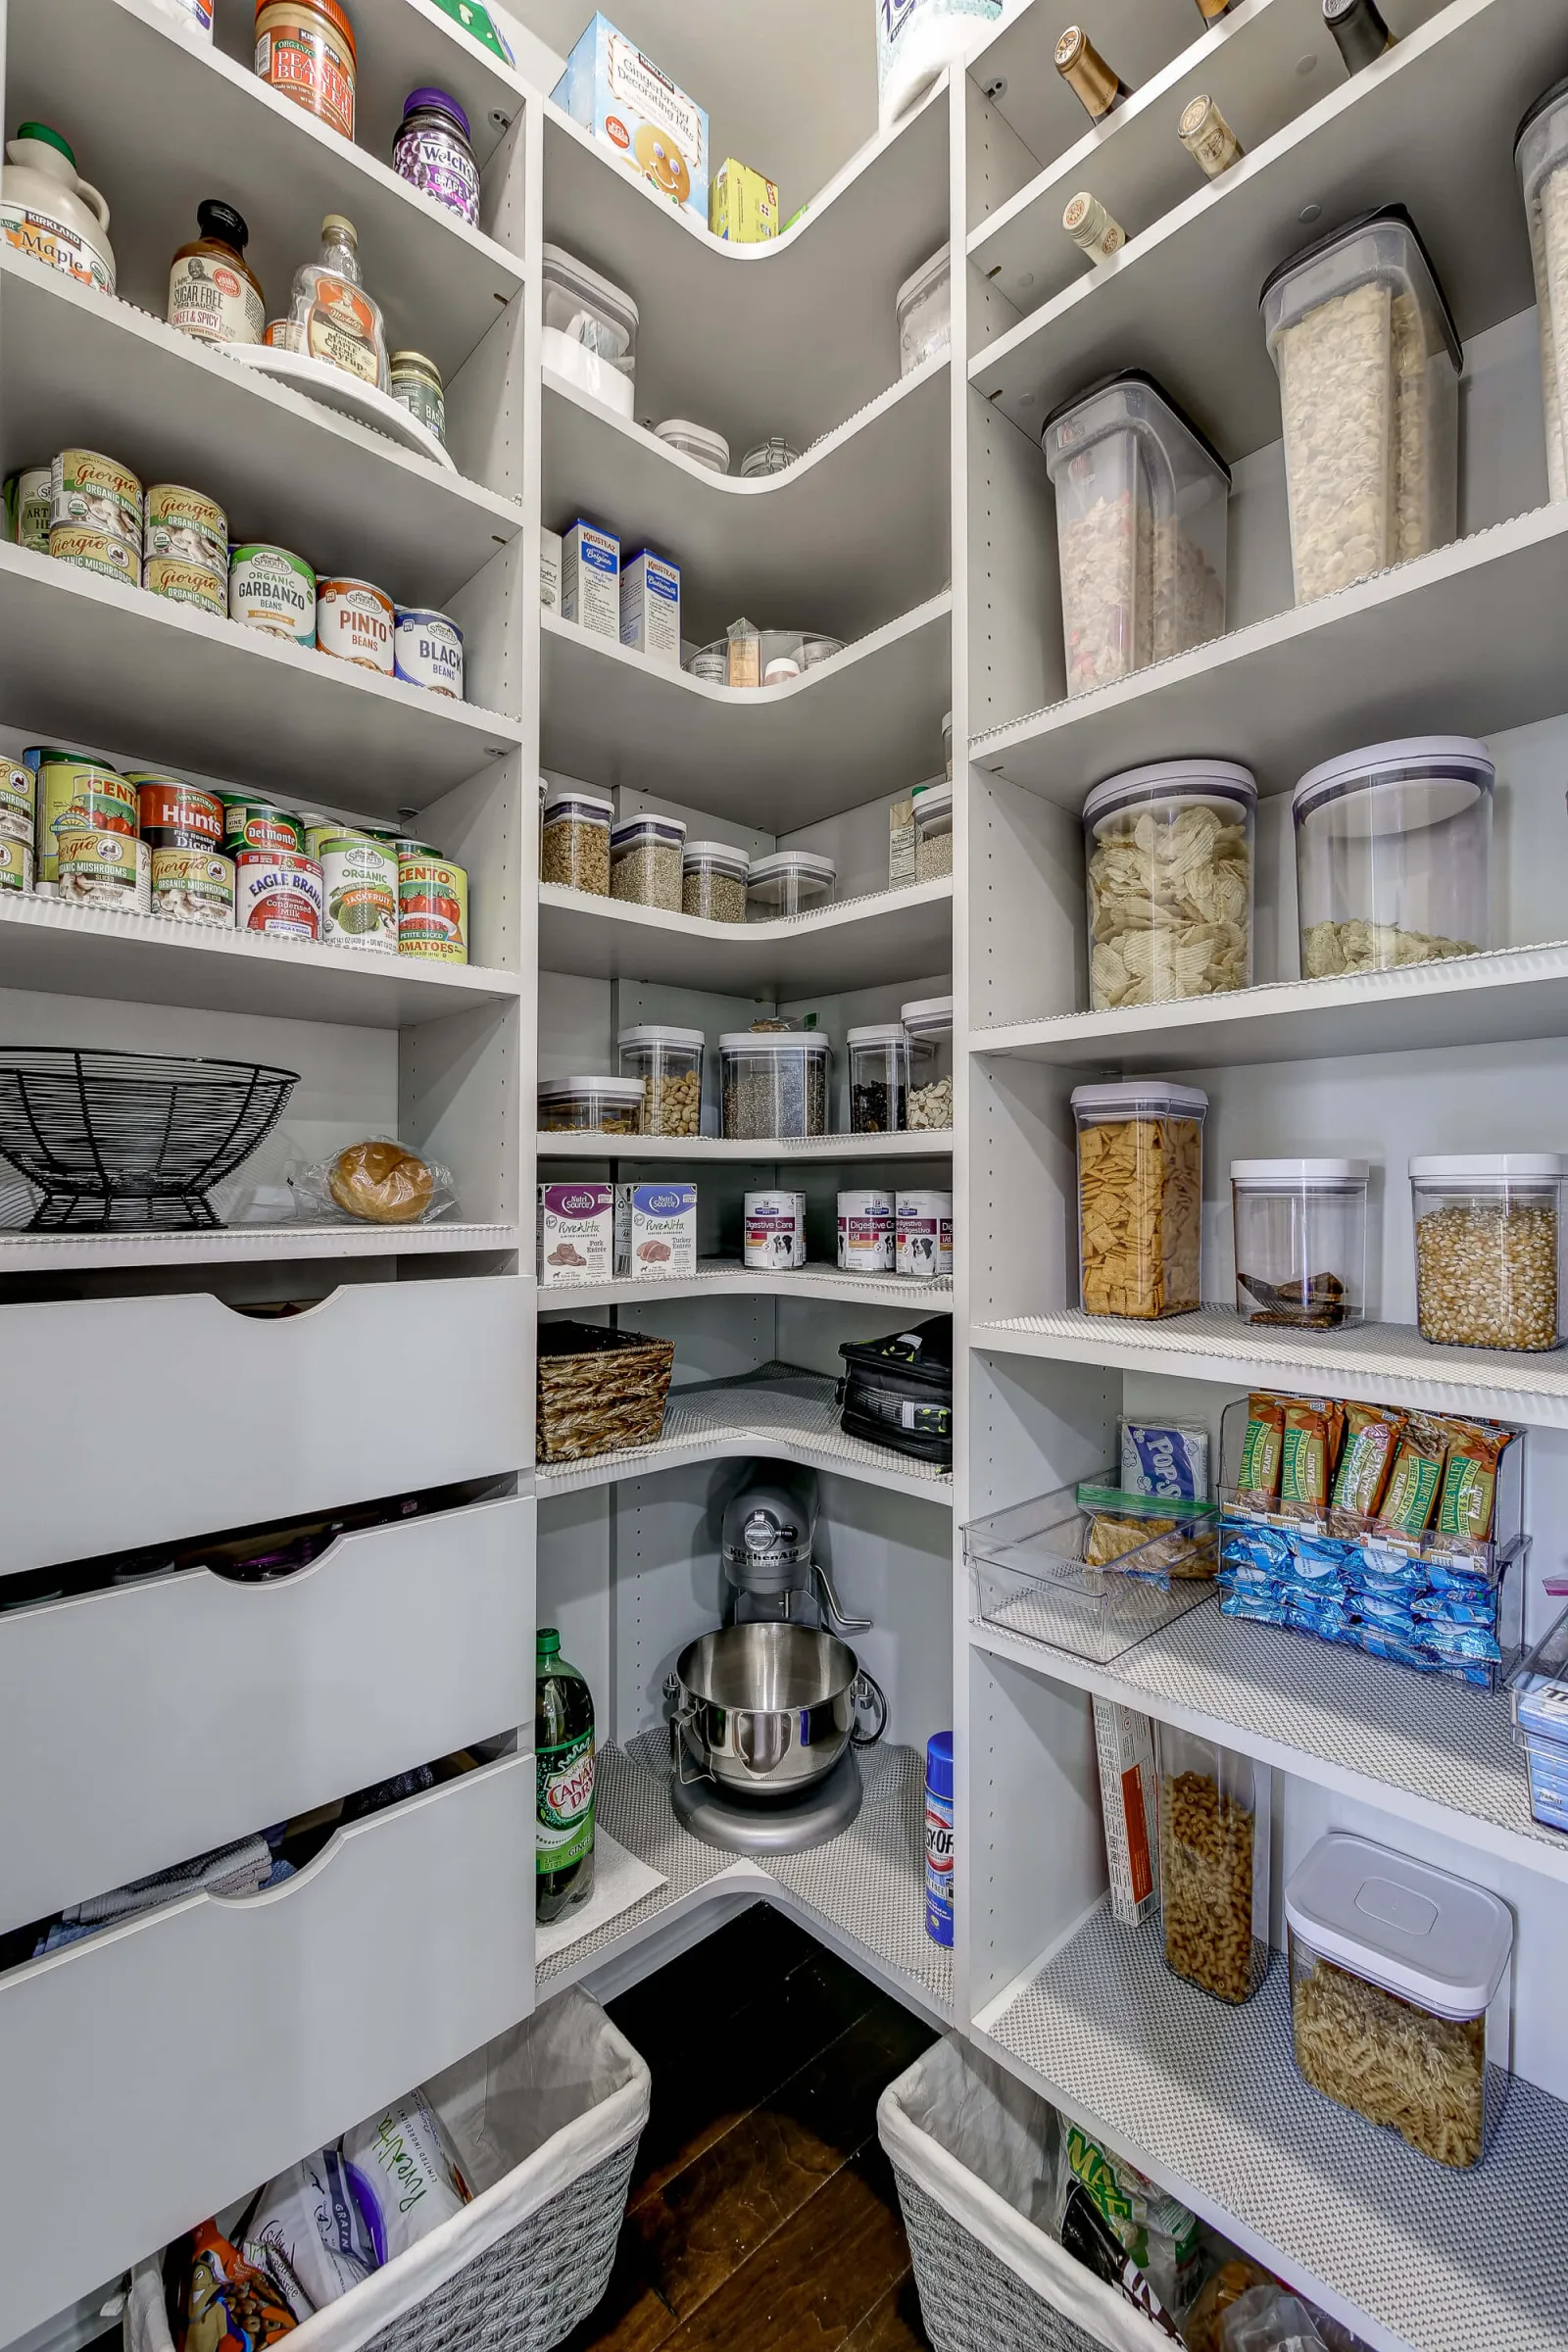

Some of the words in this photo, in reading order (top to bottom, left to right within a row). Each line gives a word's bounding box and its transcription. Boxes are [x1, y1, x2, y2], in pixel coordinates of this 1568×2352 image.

[278, 40, 317, 58] ORGANIC
[301, 29, 340, 65] KIRAND
[277, 51, 351, 106] PEANUT
[277, 65, 349, 121] BUTTER
[623, 59, 690, 124] Gingerbread
[616, 66, 674, 121] Decorating
[676, 112, 695, 143] Kits
[422, 145, 474, 178] Welch's
[434, 172, 465, 200] GRAPE
[28, 213, 80, 246] KIRKLAND
[22, 230, 83, 273] Maple
[173, 286, 198, 307] SUGAR
[200, 286, 224, 310] FREE
[191, 302, 216, 312] SAUCE
[173, 311, 190, 324] SWEET
[197, 311, 220, 328] SPICY
[330, 310, 362, 330] Michele's
[327, 332, 359, 354] MAPLE
[330, 348, 365, 372] Syrup
[76, 464, 138, 494] Giorgio
[85, 483, 121, 505] ORGANIC
[159, 496, 219, 520] Giorgio
[168, 515, 200, 532] ORGANIC
[52, 533, 109, 558] Giorgio
[583, 531, 615, 553] KRUSTEAZ
[254, 557, 290, 571] SPROUTS
[586, 548, 612, 565] Belgian
[85, 560, 133, 584] MUSHROOMS
[159, 568, 219, 594] Giorgio
[248, 571, 295, 589] ORGANIC
[648, 561, 677, 582] KRUSTEAZ
[168, 587, 200, 604] ORGANIC
[238, 581, 305, 611] GARBANZO
[647, 574, 677, 596] Buttermilk
[260, 599, 282, 612] BEANS
[349, 594, 381, 612] SPROUTS
[340, 610, 387, 643] PINTO
[352, 634, 378, 652] BEANS
[419, 639, 462, 674] BLACK
[432, 663, 456, 681] BEANS
[0, 790, 31, 811] SHROOMS
[87, 778, 135, 808] CENT
[192, 795, 215, 809] NATURAL
[163, 805, 221, 836] Hunt's
[176, 836, 215, 853] Diced
[190, 832, 217, 846] Roasted
[249, 827, 266, 839] Del
[266, 829, 296, 846] Monte
[76, 862, 127, 877] MUSHROOMS
[154, 857, 209, 879] Giorgio
[348, 852, 383, 865] SPROUTS
[341, 869, 388, 883] ORGANIC
[398, 867, 450, 883] CENTO
[158, 879, 186, 889] ORGANIC
[187, 880, 229, 898] MUSHROOMS
[249, 873, 289, 897] EAGLE
[292, 874, 321, 909] BRAND
[345, 893, 391, 906] JACKFRUIT
[266, 900, 312, 913] Condensed
[280, 907, 301, 918] Milk
[398, 941, 454, 954] OMATOES
[850, 1220, 886, 1231] Digestive
[1244, 1423, 1262, 1451] VALLEY
[1260, 1424, 1272, 1438] NUT
[1300, 1431, 1311, 1447] NUT
[1254, 1439, 1265, 1458] SALTY
[1285, 1431, 1300, 1460] VALLEY
[1239, 1451, 1255, 1488] NATURE
[1262, 1445, 1273, 1474] PEANUT
[1296, 1448, 1304, 1469] SALTY
[1306, 1451, 1316, 1484] PEANUT
[1408, 1456, 1418, 1479] SWEET
[1466, 1460, 1480, 1478] NUT
[1252, 1466, 1261, 1490] SWEET
[1283, 1460, 1298, 1499] NATURE
[1419, 1458, 1436, 1499] NATURE
[1450, 1458, 1466, 1493] VALLEY
[1297, 1476, 1309, 1500] SWEET
[1391, 1472, 1407, 1504] PEANUT
[1459, 1480, 1472, 1499] SALTY
[1403, 1491, 1416, 1512] SALTY
[1471, 1485, 1485, 1519] PEANUT
[1392, 1514, 1405, 1530] NUT
[1409, 1500, 1428, 1536] VALLEY
[1442, 1494, 1459, 1534] NATURE
[1458, 1509, 1470, 1537] SWEET
[730, 1547, 799, 1560] KitchenAid
[570, 1777, 594, 1809] DRY
[1539, 1790, 1563, 1804] Trident
[932, 1883, 945, 1896] FREE
[397, 2108, 420, 2149] INGREDIENT
[416, 2151, 438, 2183] LIMITED
[334, 2203, 351, 2248] GRAIN
